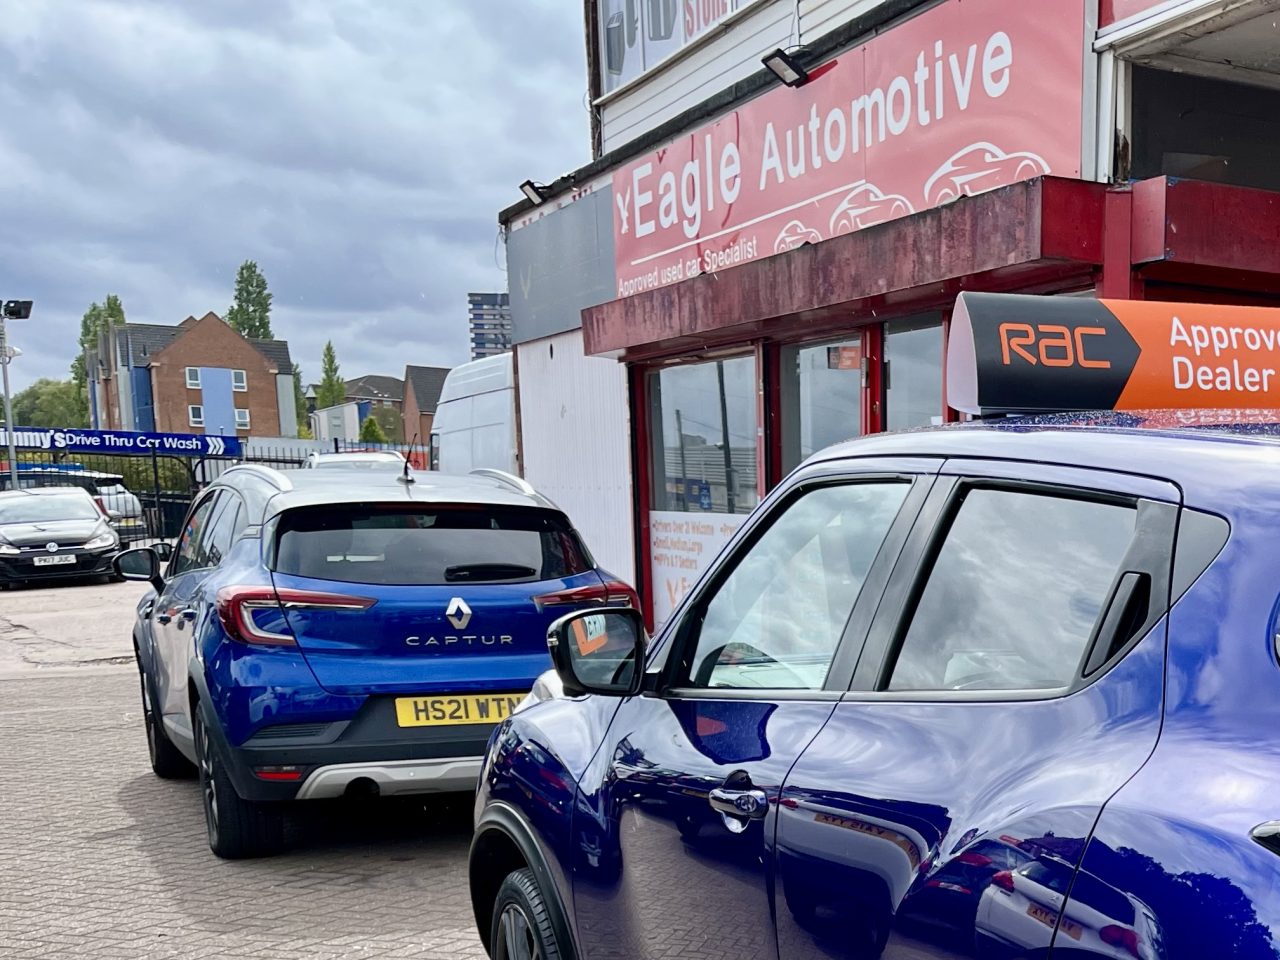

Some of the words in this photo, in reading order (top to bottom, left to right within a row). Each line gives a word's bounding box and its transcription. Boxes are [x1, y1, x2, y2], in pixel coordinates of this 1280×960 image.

[632, 133, 741, 239] Eagle
[759, 31, 1013, 191] Automotive
[618, 265, 659, 297] Approved
[661, 258, 683, 284] used
[685, 256, 702, 277] car
[704, 235, 757, 272] Specialist
[1172, 355, 1276, 394] Dealer
[66, 433, 101, 446] Drive
[102, 434, 134, 447] Thru
[136, 436, 161, 448] Car
[163, 437, 202, 450] Wash
[405, 635, 514, 646] CAPTUR
[412, 699, 470, 721] HS21
